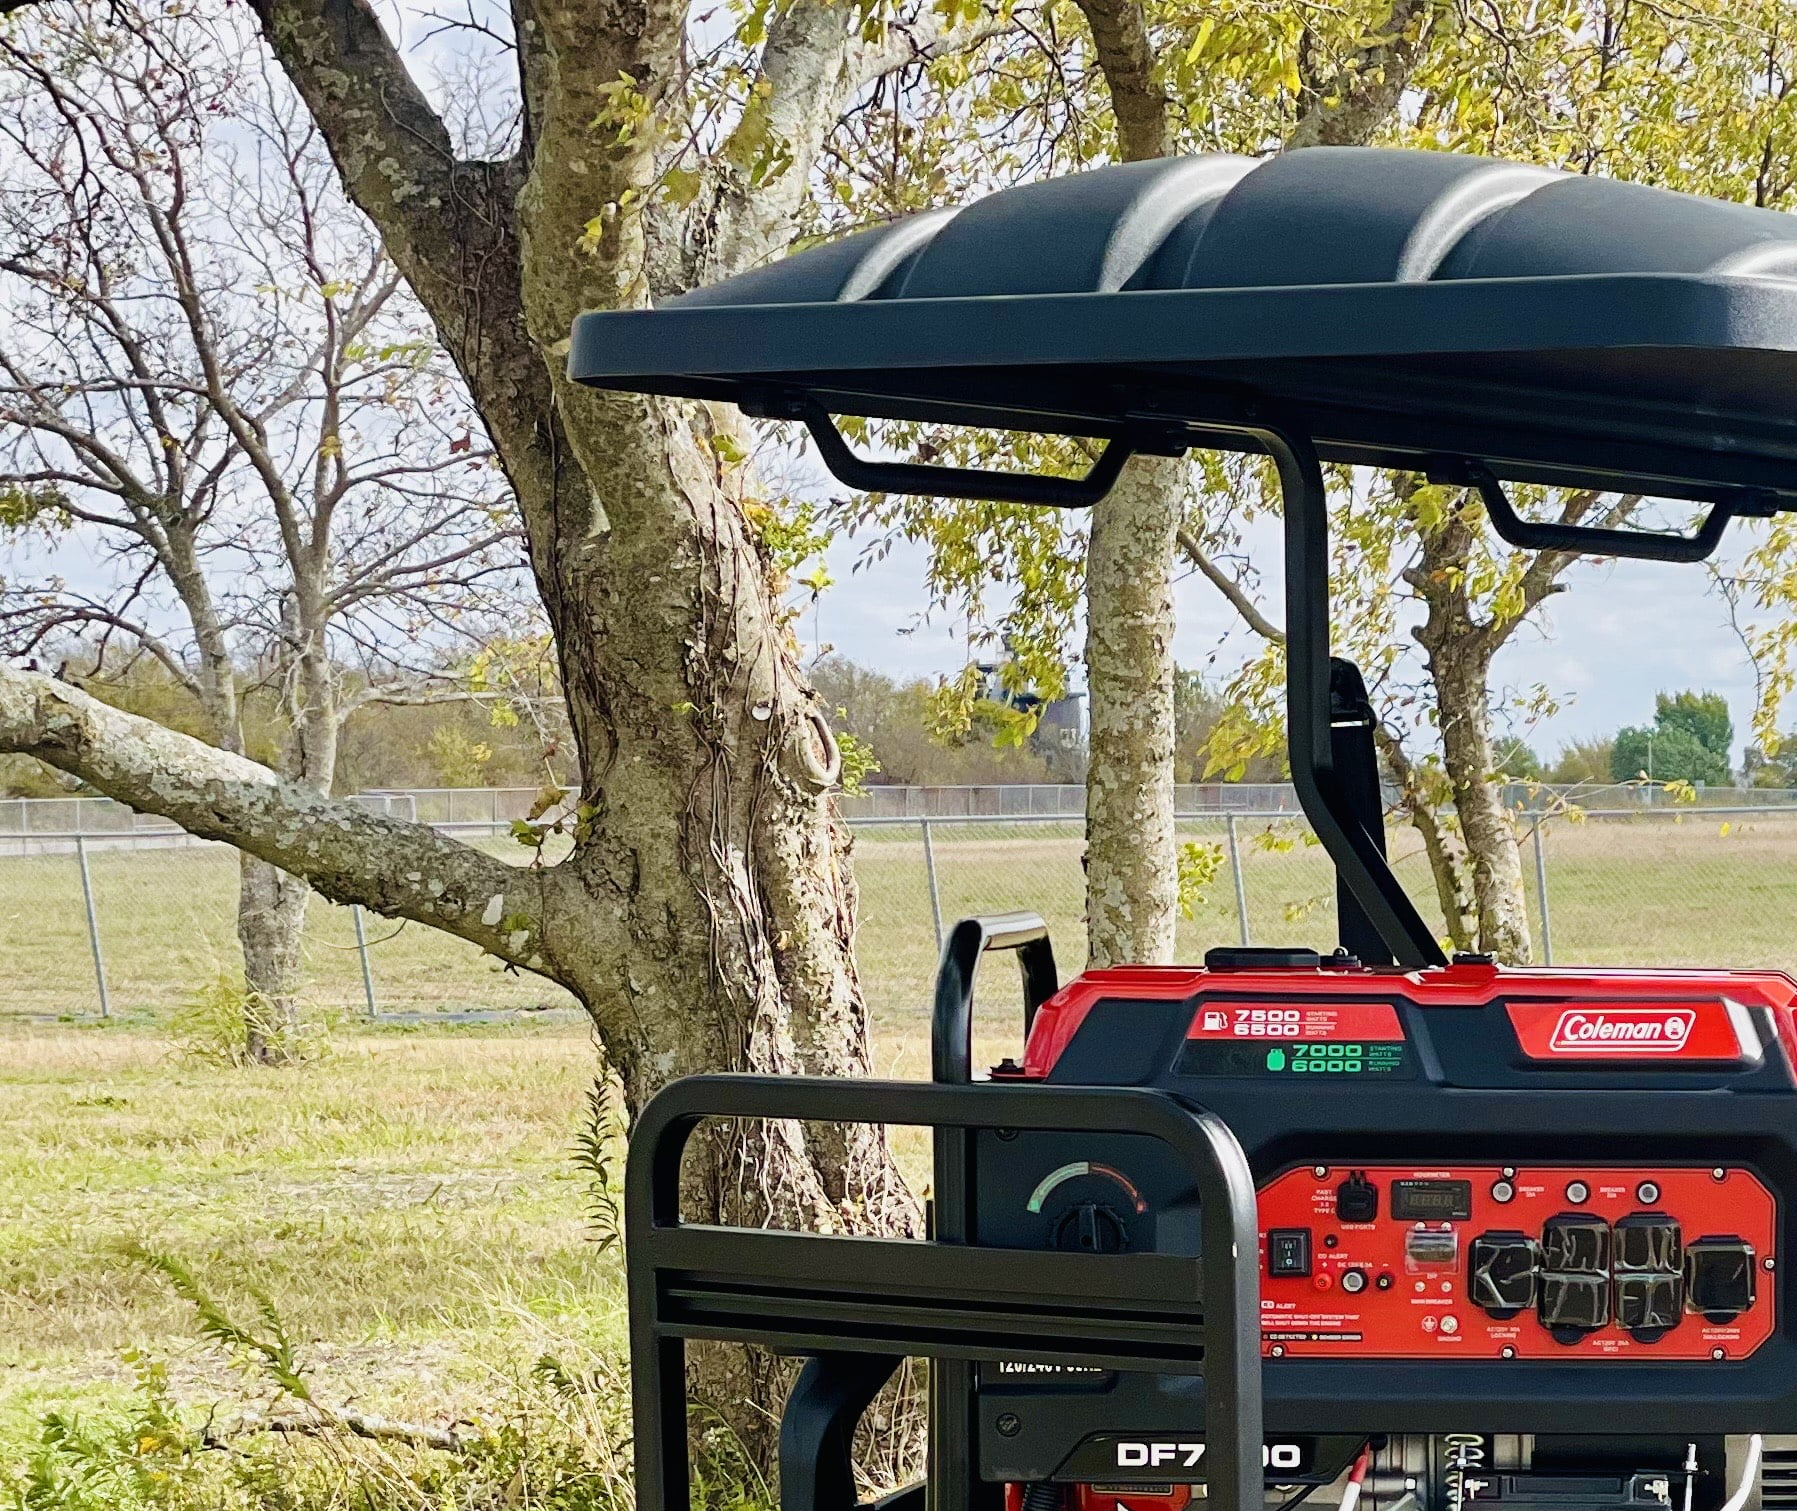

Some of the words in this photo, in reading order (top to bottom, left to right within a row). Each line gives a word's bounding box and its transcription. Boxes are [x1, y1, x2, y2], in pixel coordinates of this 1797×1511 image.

[1234, 1009, 1300, 1021] 7500
[1233, 1023, 1300, 1036] 6500
[1563, 1015, 1662, 1041] Coleman
[1292, 1044, 1362, 1057] 7000
[1291, 1060, 1361, 1072] 6000
[1117, 1443, 1301, 1468] DF70
